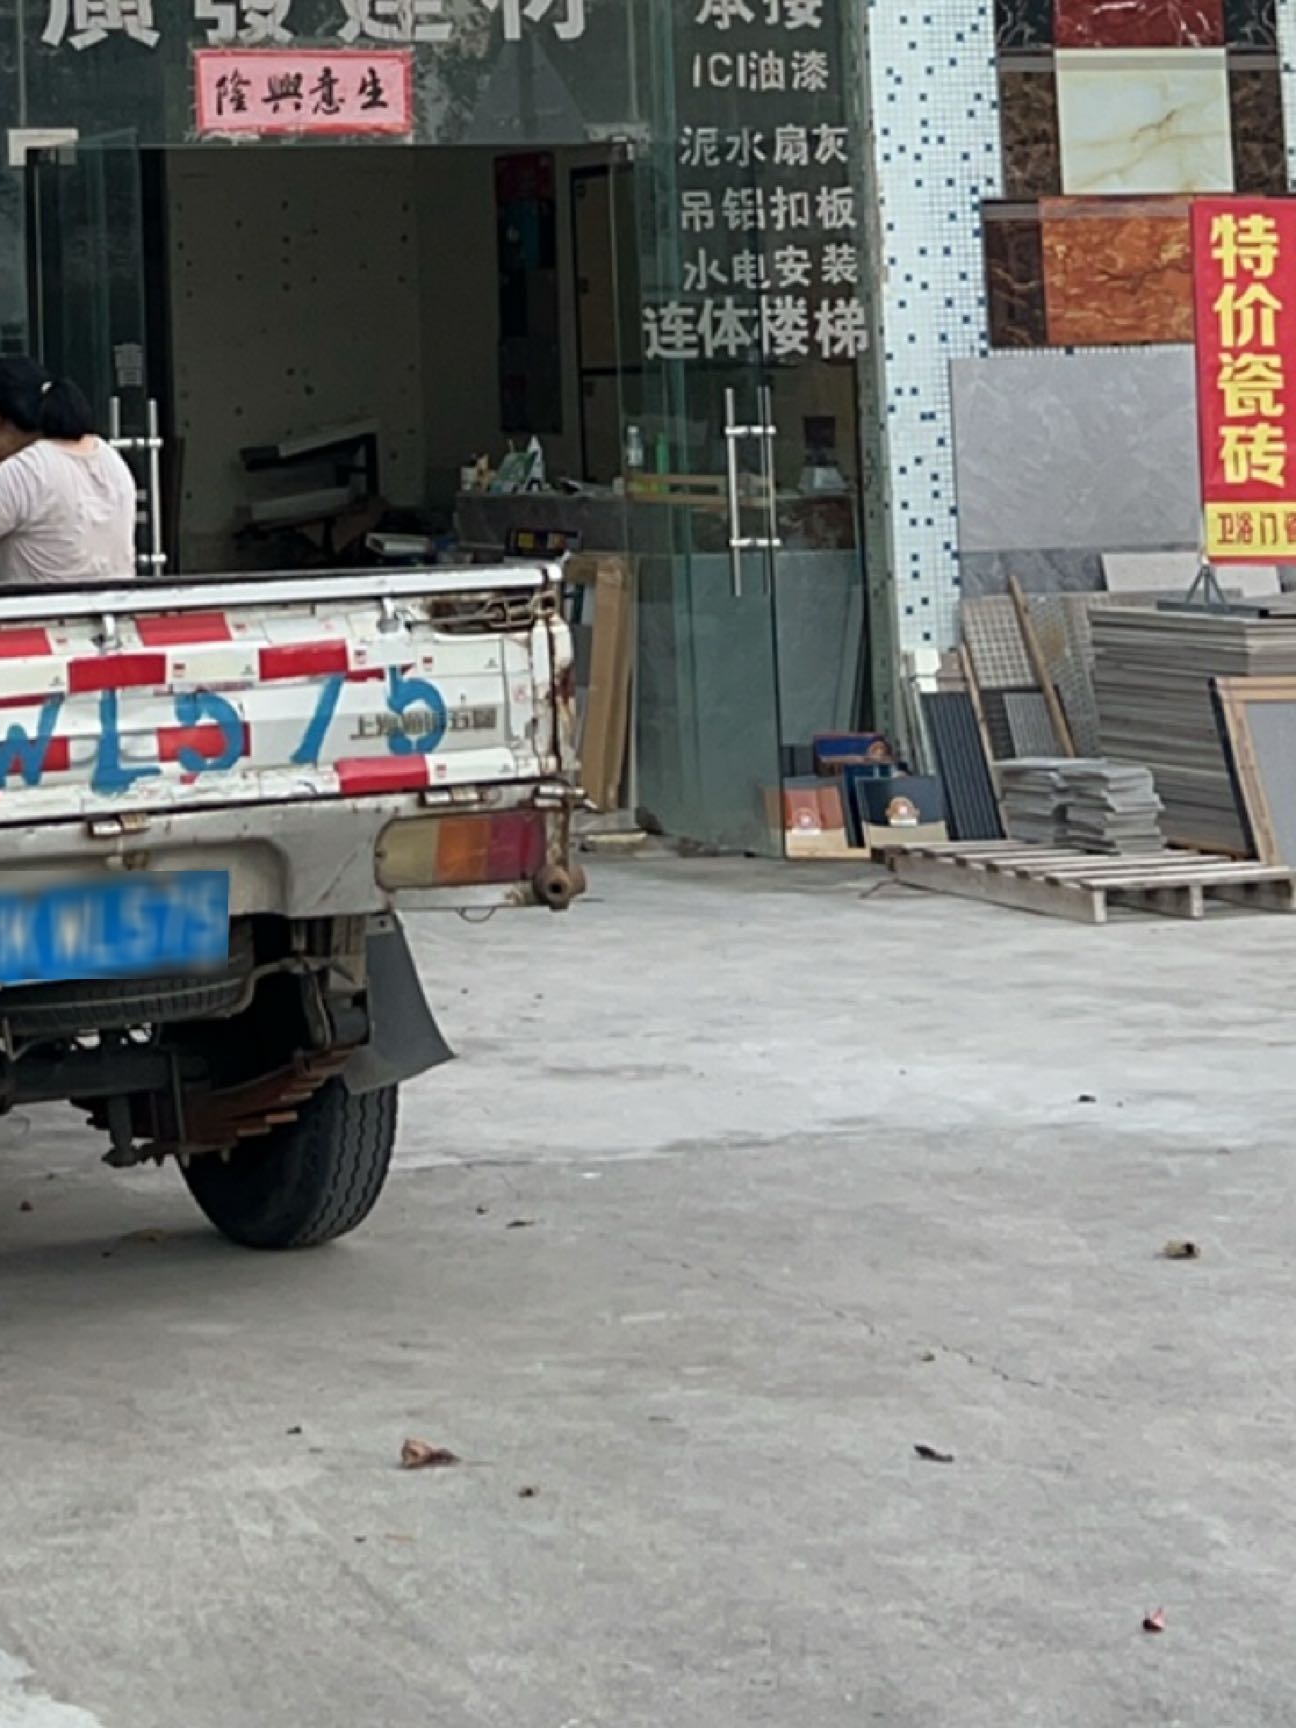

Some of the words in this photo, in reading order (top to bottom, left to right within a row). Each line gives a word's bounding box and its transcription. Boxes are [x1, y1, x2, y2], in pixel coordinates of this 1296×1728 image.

[692, 49, 829, 92] ICI油漆
[679, 123, 849, 168] 泥水扇灰
[680, 186, 858, 232] 吊铝扣板
[682, 243, 859, 291] 水电安装
[641, 295, 869, 360] 连体楼梯
[1210, 212, 1288, 489] 特价瓷砖
